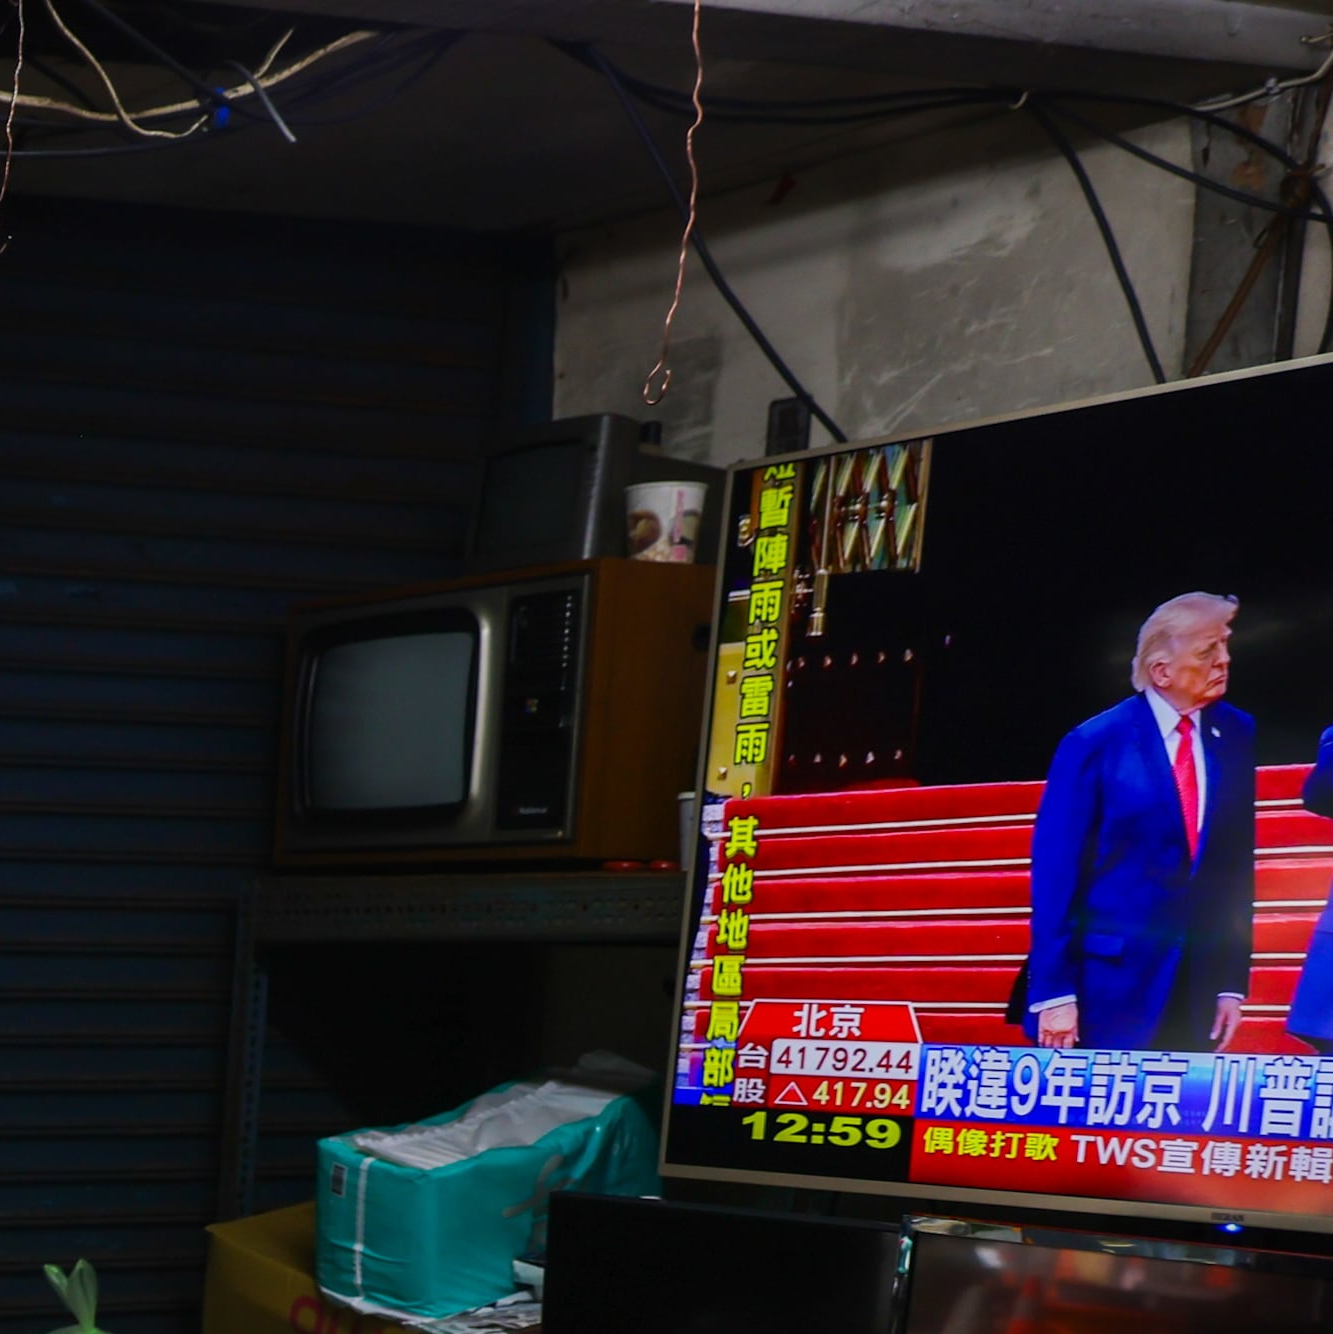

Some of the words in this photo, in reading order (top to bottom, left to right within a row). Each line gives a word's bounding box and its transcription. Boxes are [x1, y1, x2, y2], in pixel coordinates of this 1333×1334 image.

[792, 1003, 865, 1038] 北京
[776, 1046, 913, 1074] 41792.44
[812, 1080, 911, 1110] 417.94
[921, 1048, 1190, 1129] 睽違9年訪京
[742, 1111, 902, 1149] 12:59
[923, 1126, 1060, 1161] 偶像打歌
